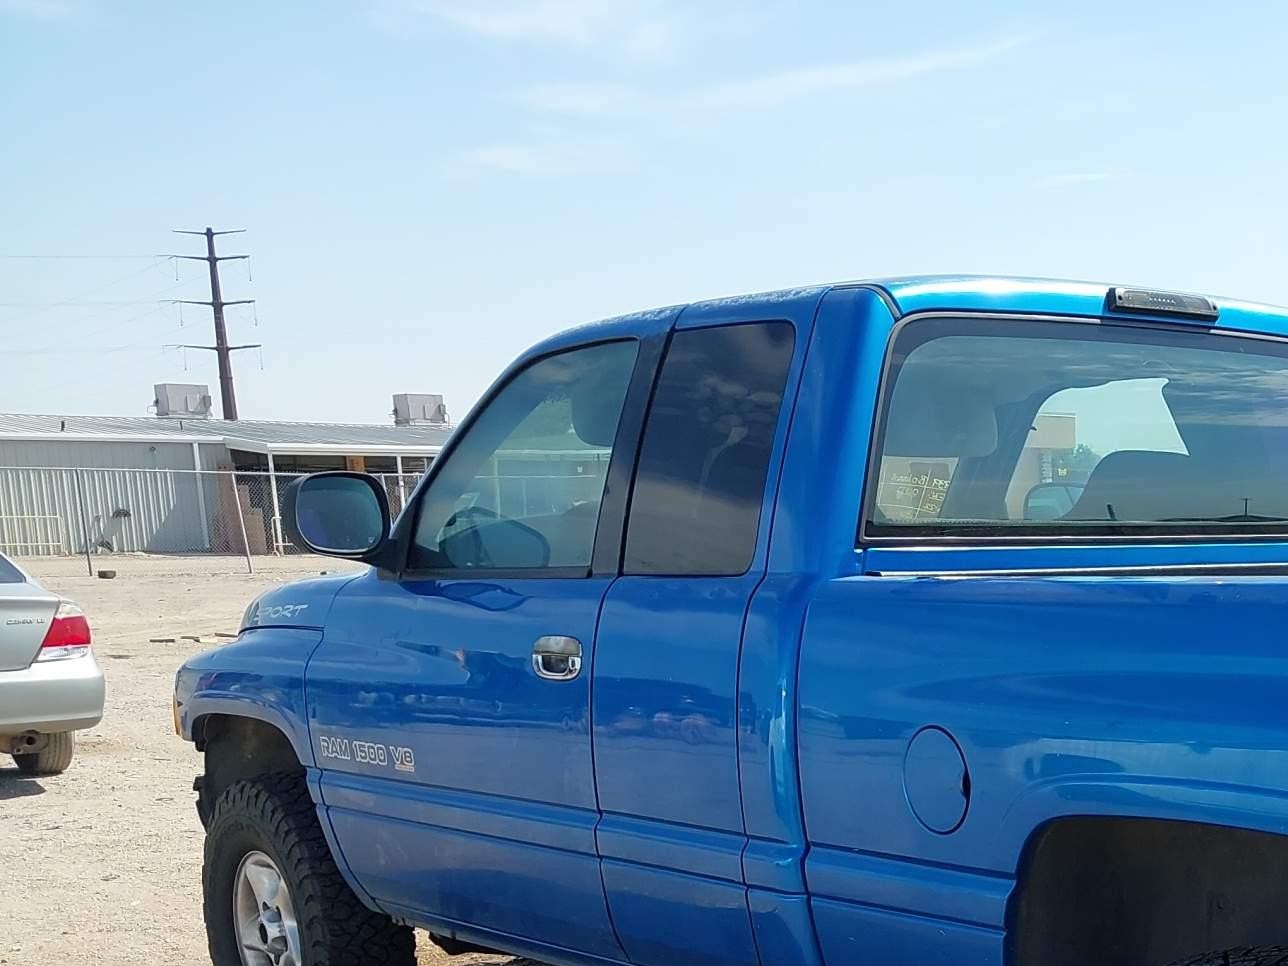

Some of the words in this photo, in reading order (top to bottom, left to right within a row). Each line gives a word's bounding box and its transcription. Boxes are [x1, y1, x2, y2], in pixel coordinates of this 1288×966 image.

[319, 736, 350, 760] RAM
[352, 741, 387, 765] 1500
[389, 745, 415, 766] V8
